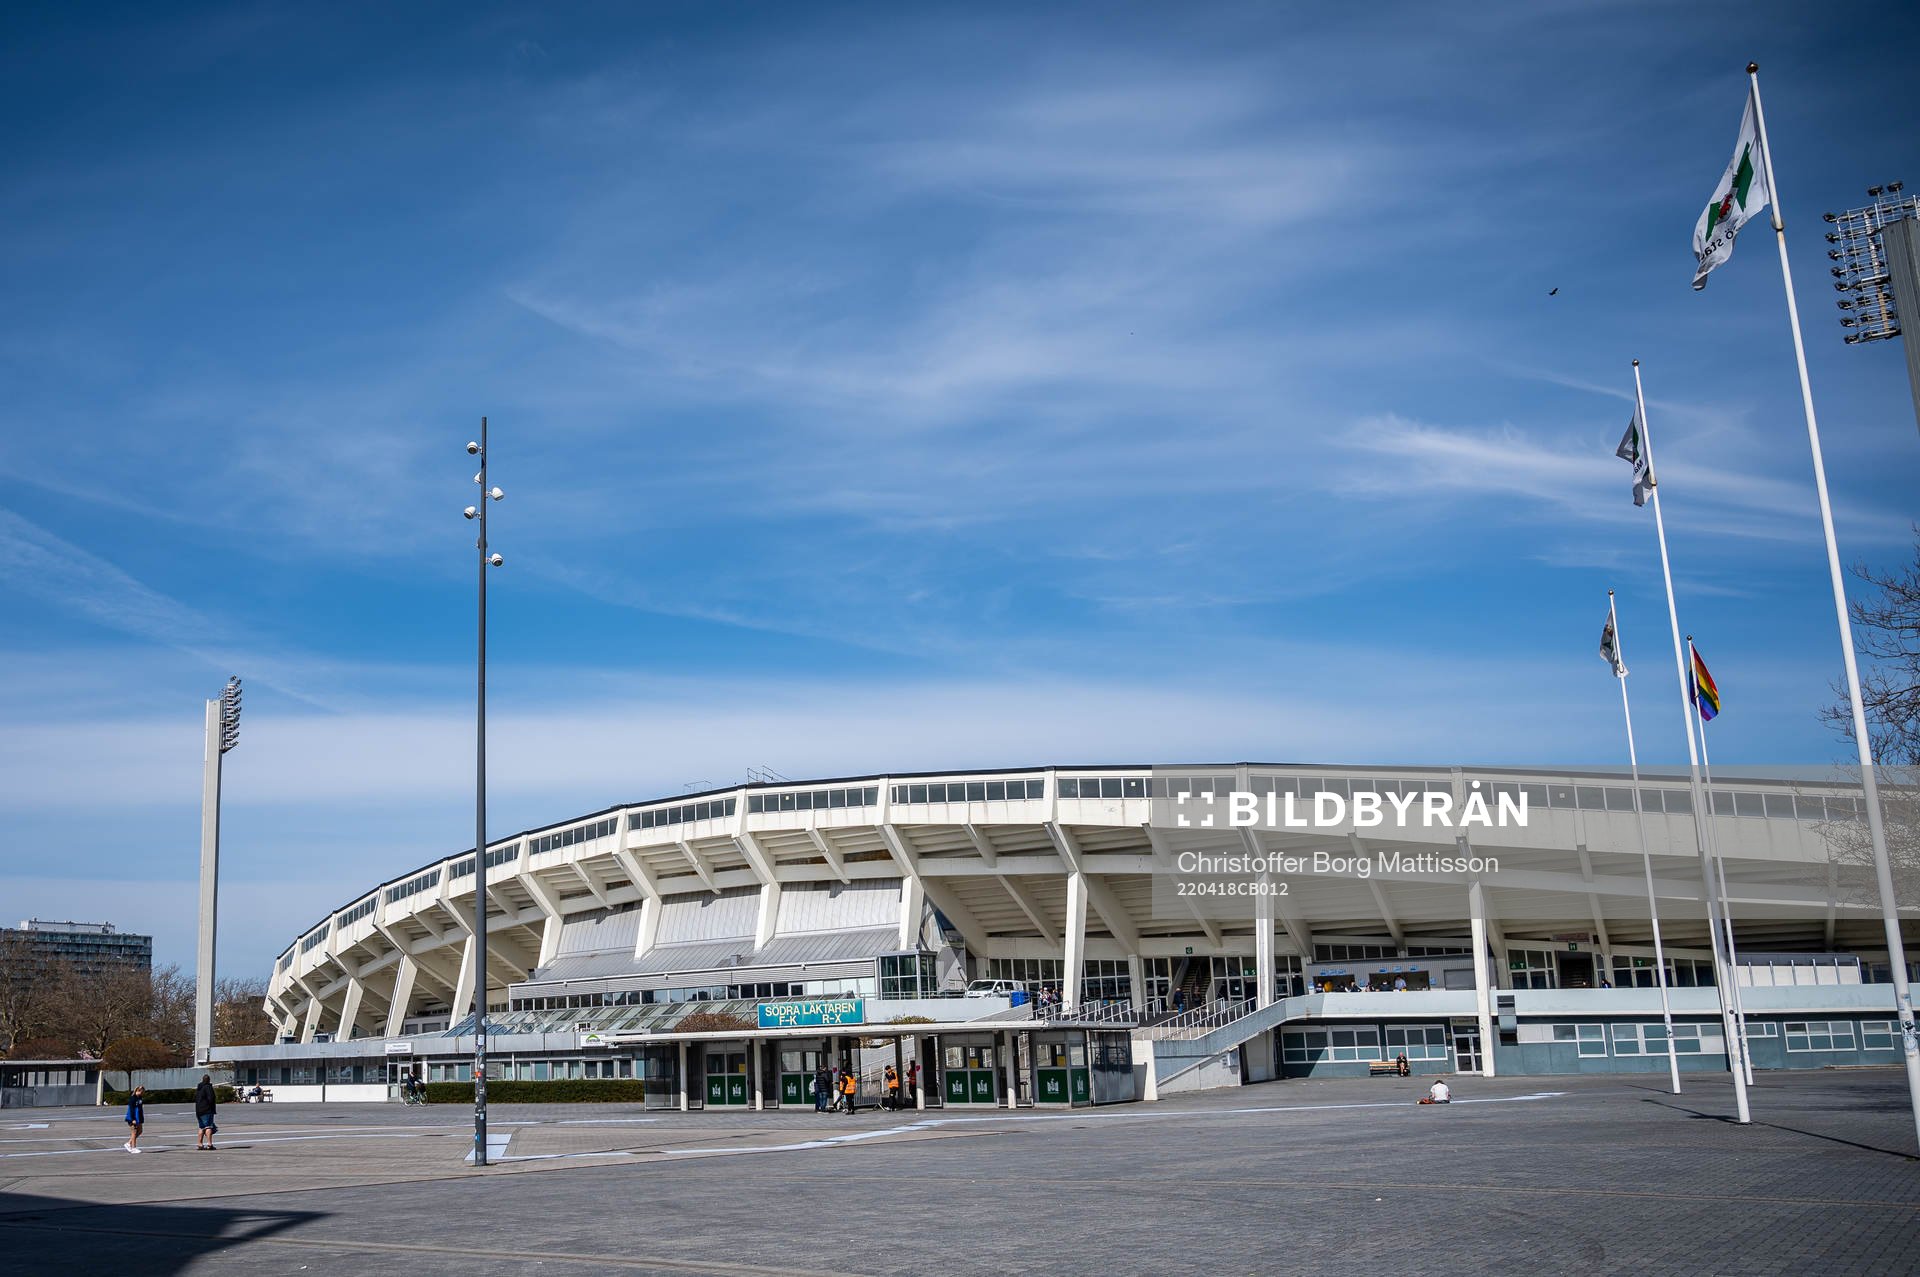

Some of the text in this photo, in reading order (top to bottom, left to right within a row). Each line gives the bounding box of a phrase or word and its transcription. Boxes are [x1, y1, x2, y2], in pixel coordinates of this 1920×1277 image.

[765, 1001, 856, 1017] SÖDRA LÄKTAREN
[779, 1013, 842, 1026] F-K R-X
